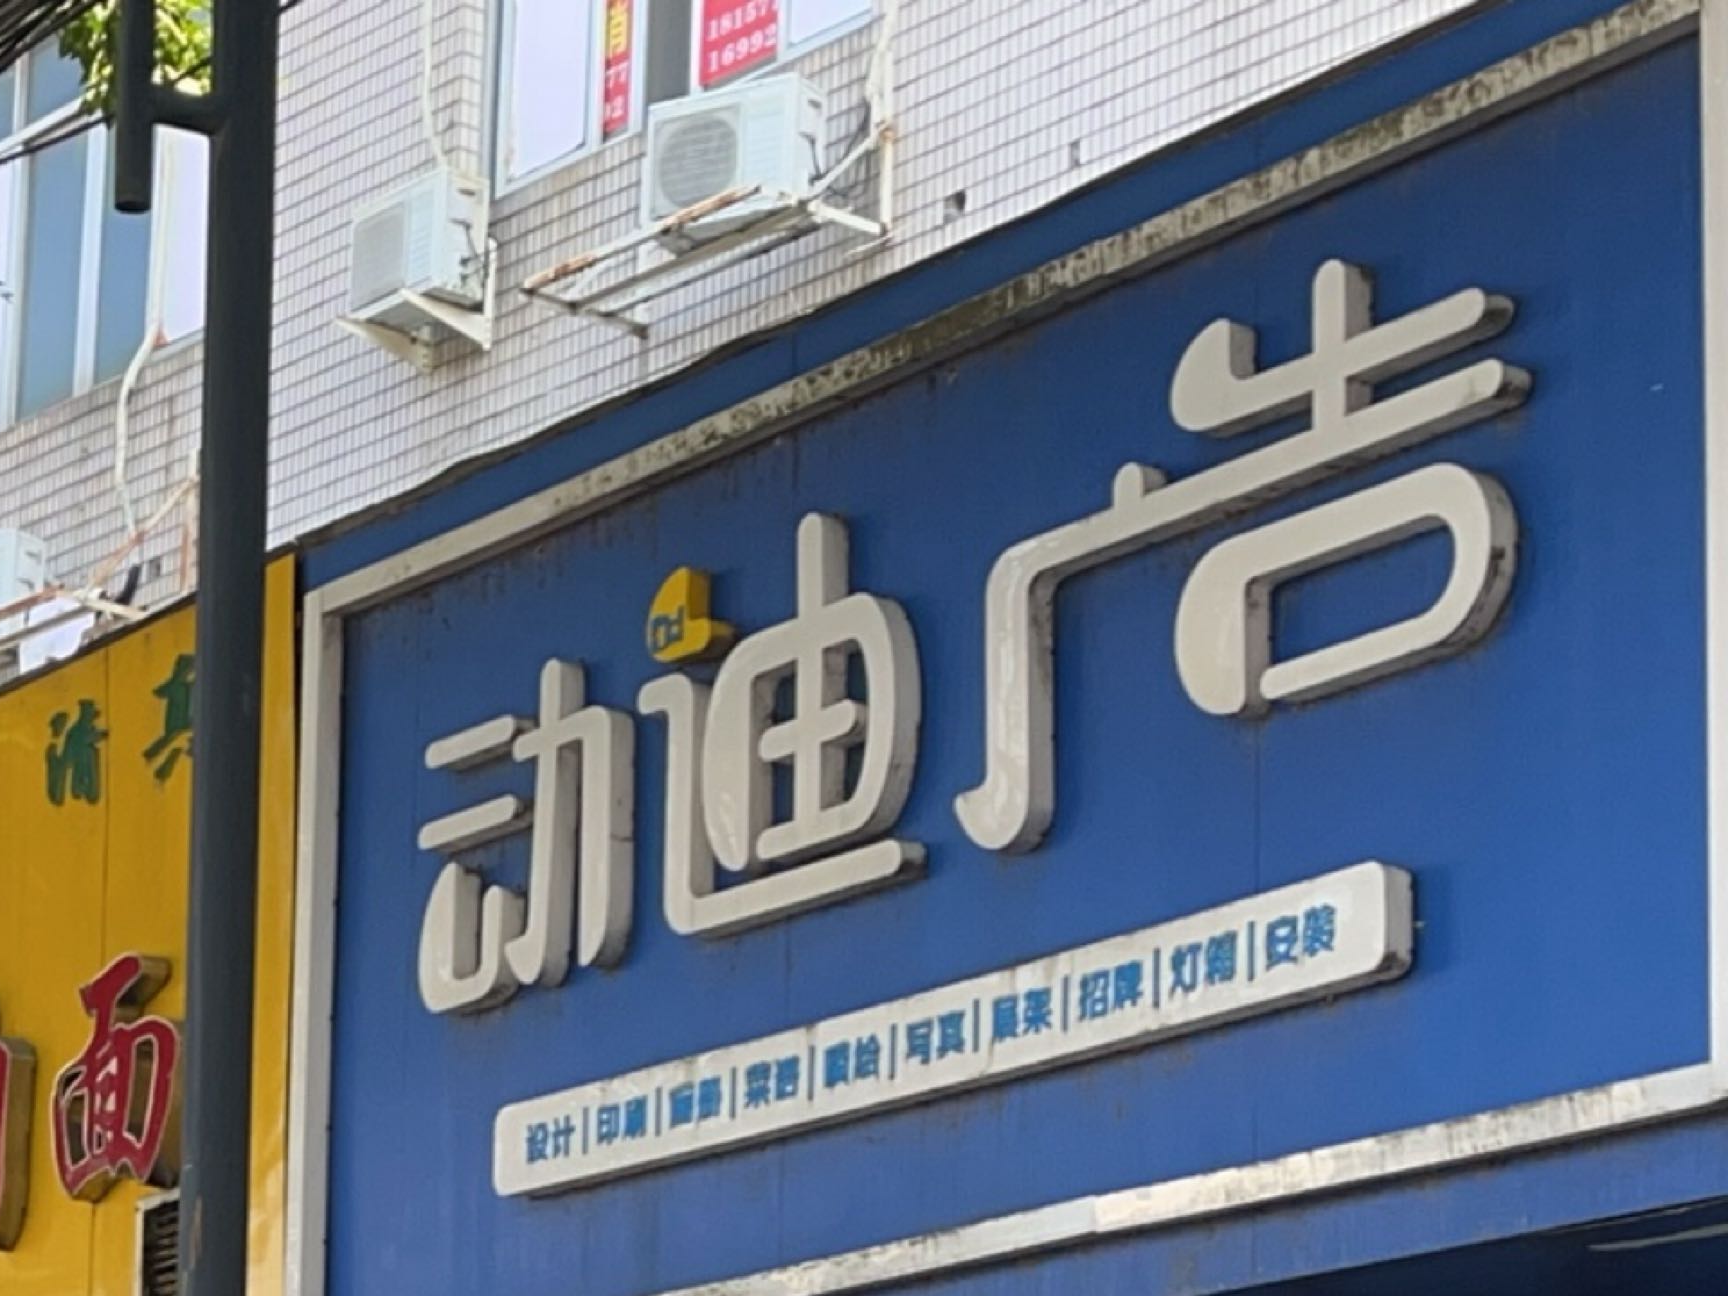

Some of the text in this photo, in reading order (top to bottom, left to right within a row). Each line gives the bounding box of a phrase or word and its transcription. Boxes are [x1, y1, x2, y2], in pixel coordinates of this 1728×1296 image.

[418, 258, 1540, 1015] 动迪广告
[525, 1113, 576, 1165] 设计
[596, 1093, 648, 1146] 印刷
[904, 1008, 966, 1066] 写真
[991, 984, 1053, 1044] 展架
[1078, 958, 1144, 1022] 招牌
[1170, 929, 1239, 996] 灯箱
[1264, 902, 1337, 971] 安装
